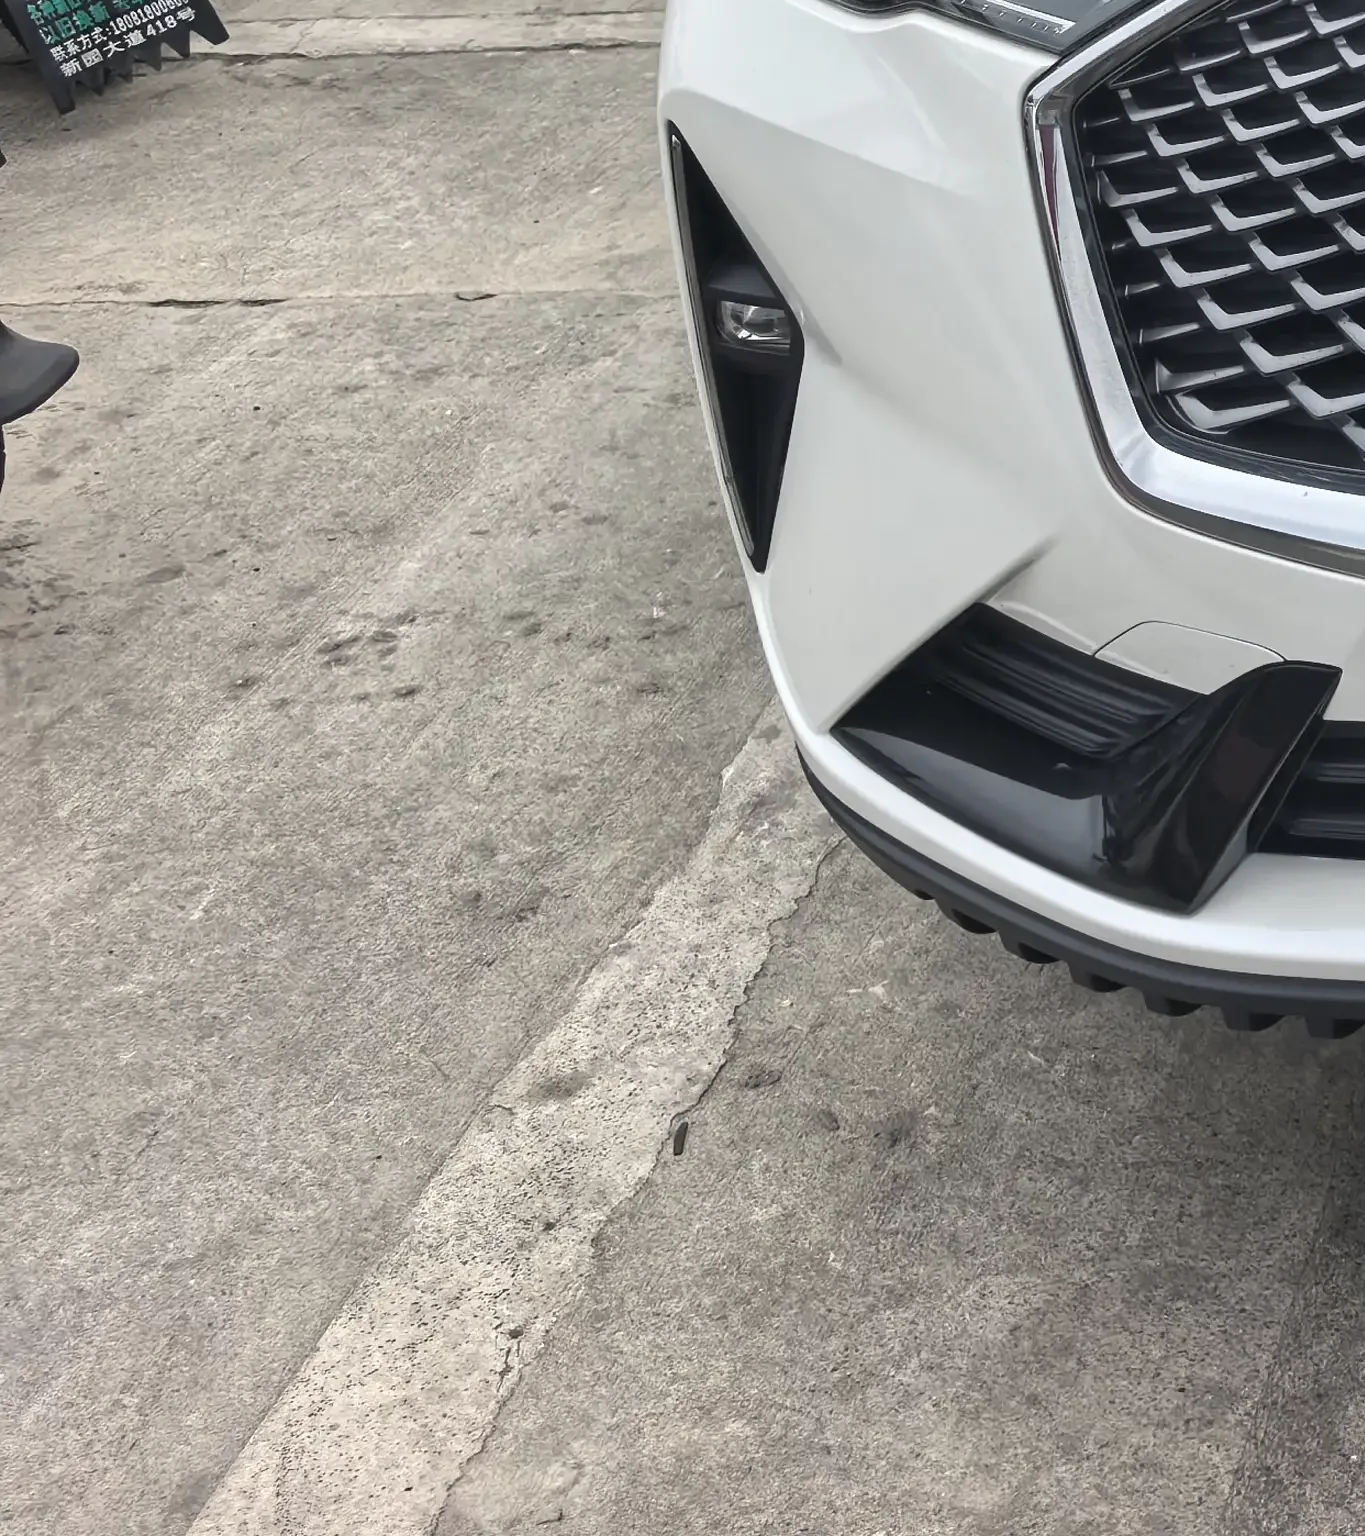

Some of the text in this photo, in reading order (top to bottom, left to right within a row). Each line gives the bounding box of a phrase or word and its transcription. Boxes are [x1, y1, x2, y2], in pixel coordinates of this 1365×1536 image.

[40, 0, 111, 45] 以旧换新
[59, 6, 197, 78] 新园大道418号
